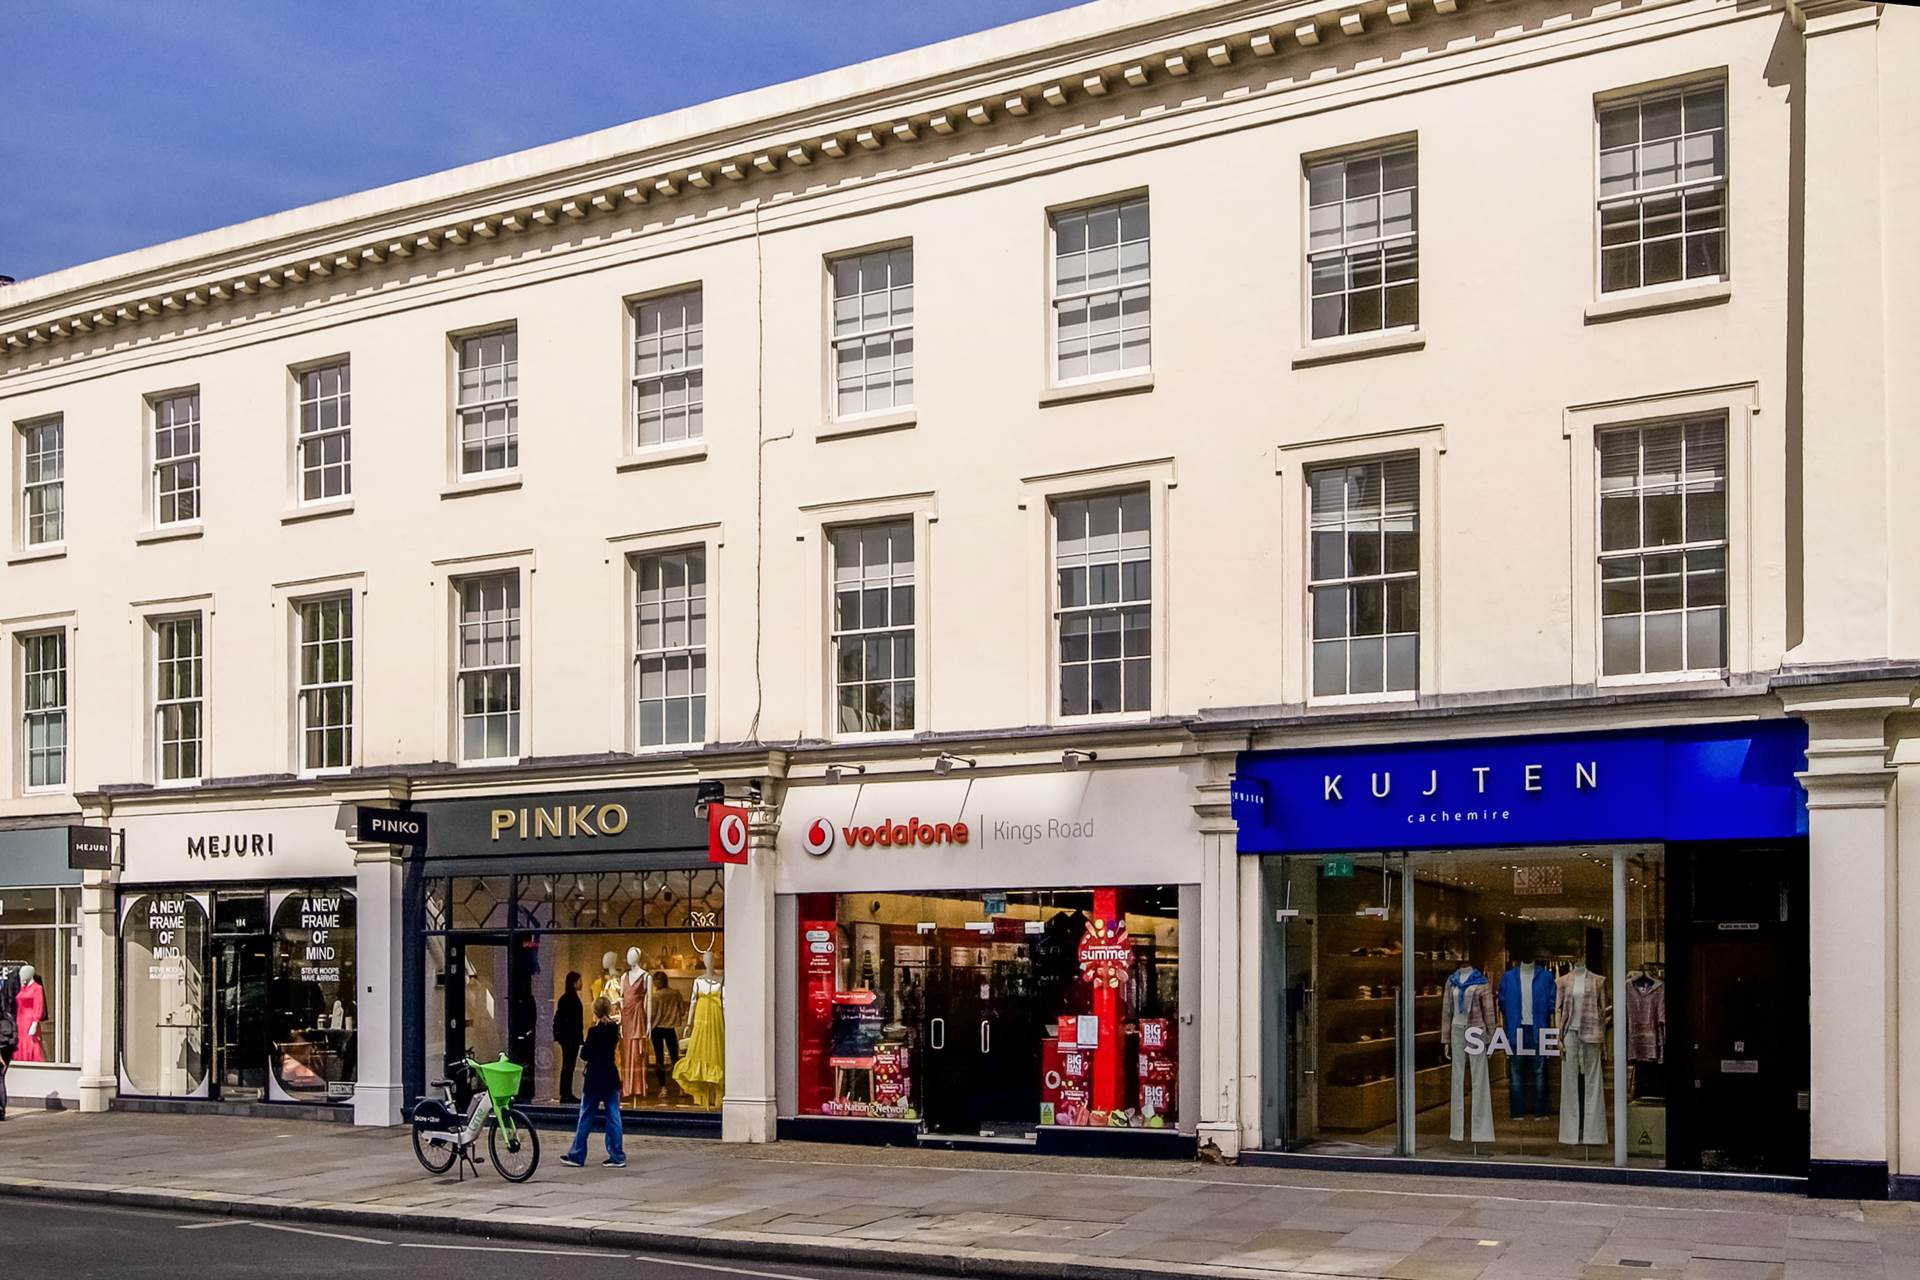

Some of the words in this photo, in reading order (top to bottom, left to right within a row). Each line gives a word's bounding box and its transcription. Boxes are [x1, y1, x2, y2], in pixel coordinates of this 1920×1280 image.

[1323, 761, 1597, 801] KUJTEN
[490, 803, 629, 840] PINKO
[1407, 808, 1511, 824] cachemire
[371, 818, 419, 834] PINKO
[842, 817, 969, 847] vodafone
[993, 820, 1042, 845] Kings
[1048, 817, 1095, 839] Road
[76, 843, 108, 852] MEJURI
[187, 833, 273, 858] MEJURI
[149, 901, 158, 914] A
[159, 900, 185, 914] NEW
[301, 899, 310, 912] A
[312, 898, 340, 912] NEW
[149, 915, 185, 929] FRAME
[301, 914, 340, 928] FRAME
[159, 931, 175, 945] OF
[312, 930, 329, 944] OF
[153, 946, 180, 960] MIND
[305, 946, 335, 961] MIND
[1081, 949, 1130, 960] summer
[1144, 1024, 1161, 1034] BIG
[1463, 1026, 1561, 1057] SALE
[1066, 1054, 1082, 1063] BIG
[1145, 1086, 1163, 1097] BIG
[828, 1101, 843, 1111] The
[844, 1101, 875, 1113] Nation's
[876, 1103, 909, 1114] Network
